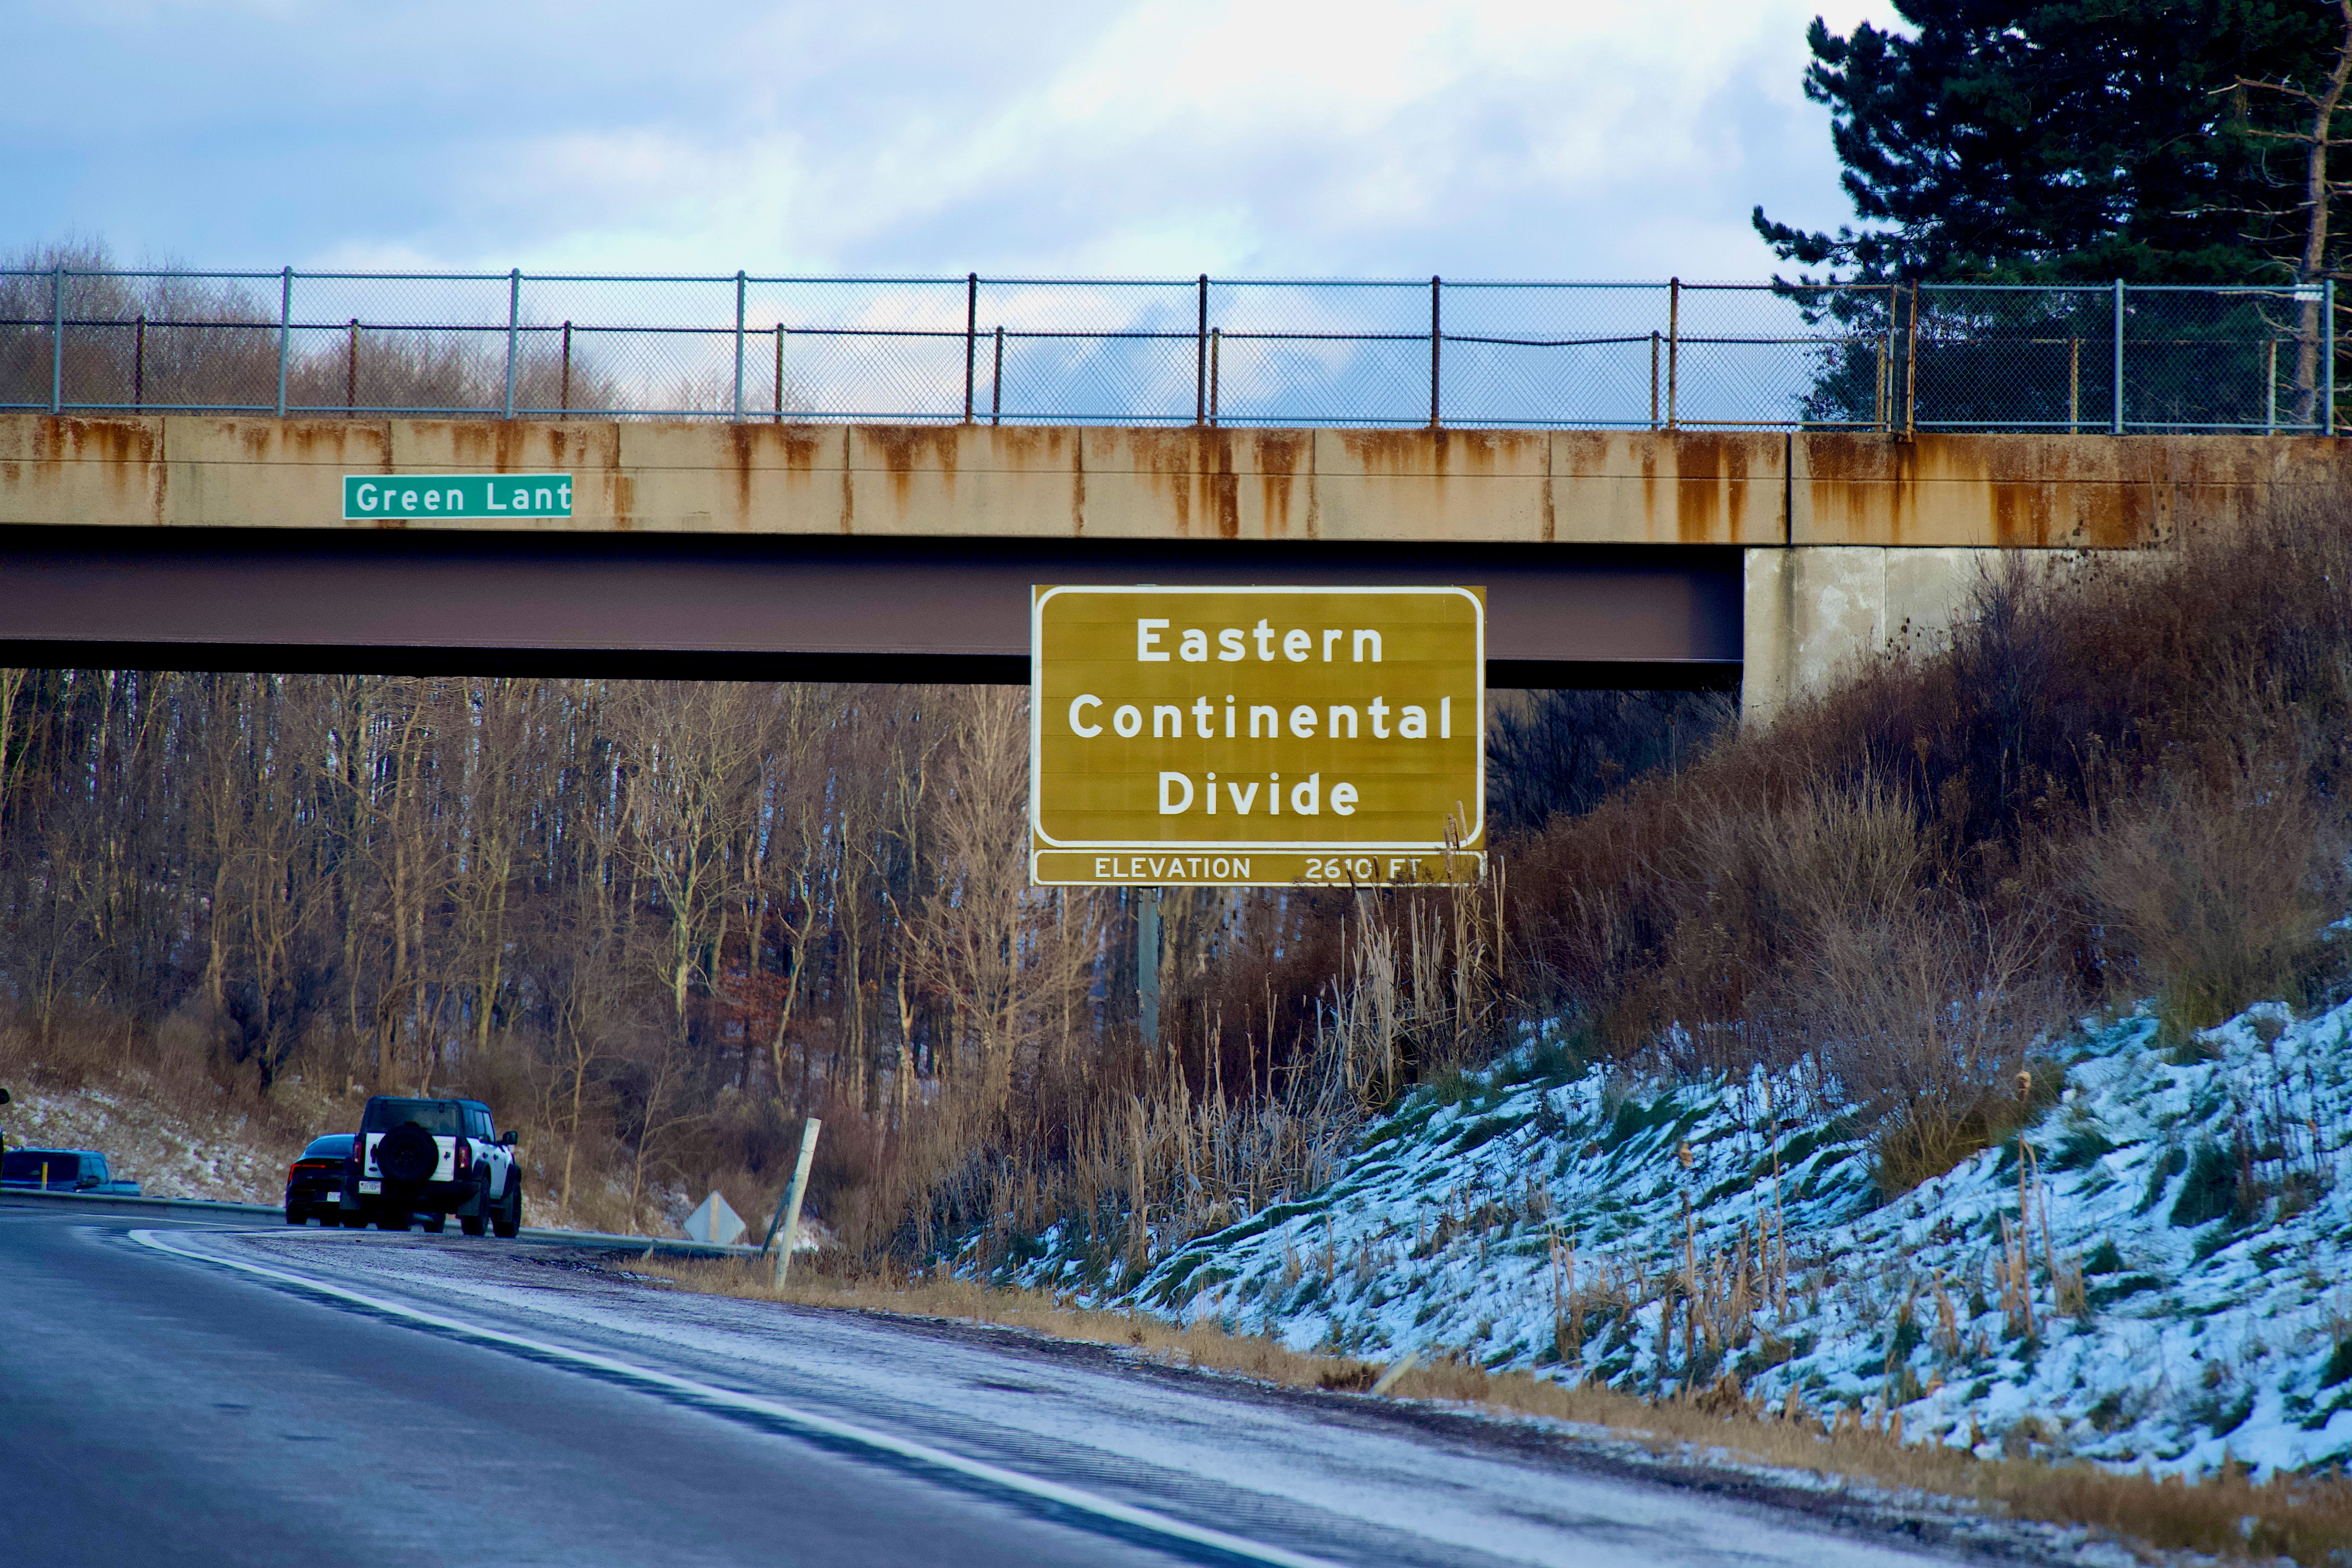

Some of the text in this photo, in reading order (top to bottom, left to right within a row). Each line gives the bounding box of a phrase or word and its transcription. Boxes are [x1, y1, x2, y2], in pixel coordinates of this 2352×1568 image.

[357, 483, 571, 511] Green Lant
[1137, 618, 1382, 662] Eastern
[1069, 694, 1450, 739] Continental
[1159, 771, 1359, 816] Divide
[1095, 857, 1422, 879] ELEVATION 2610 FT
